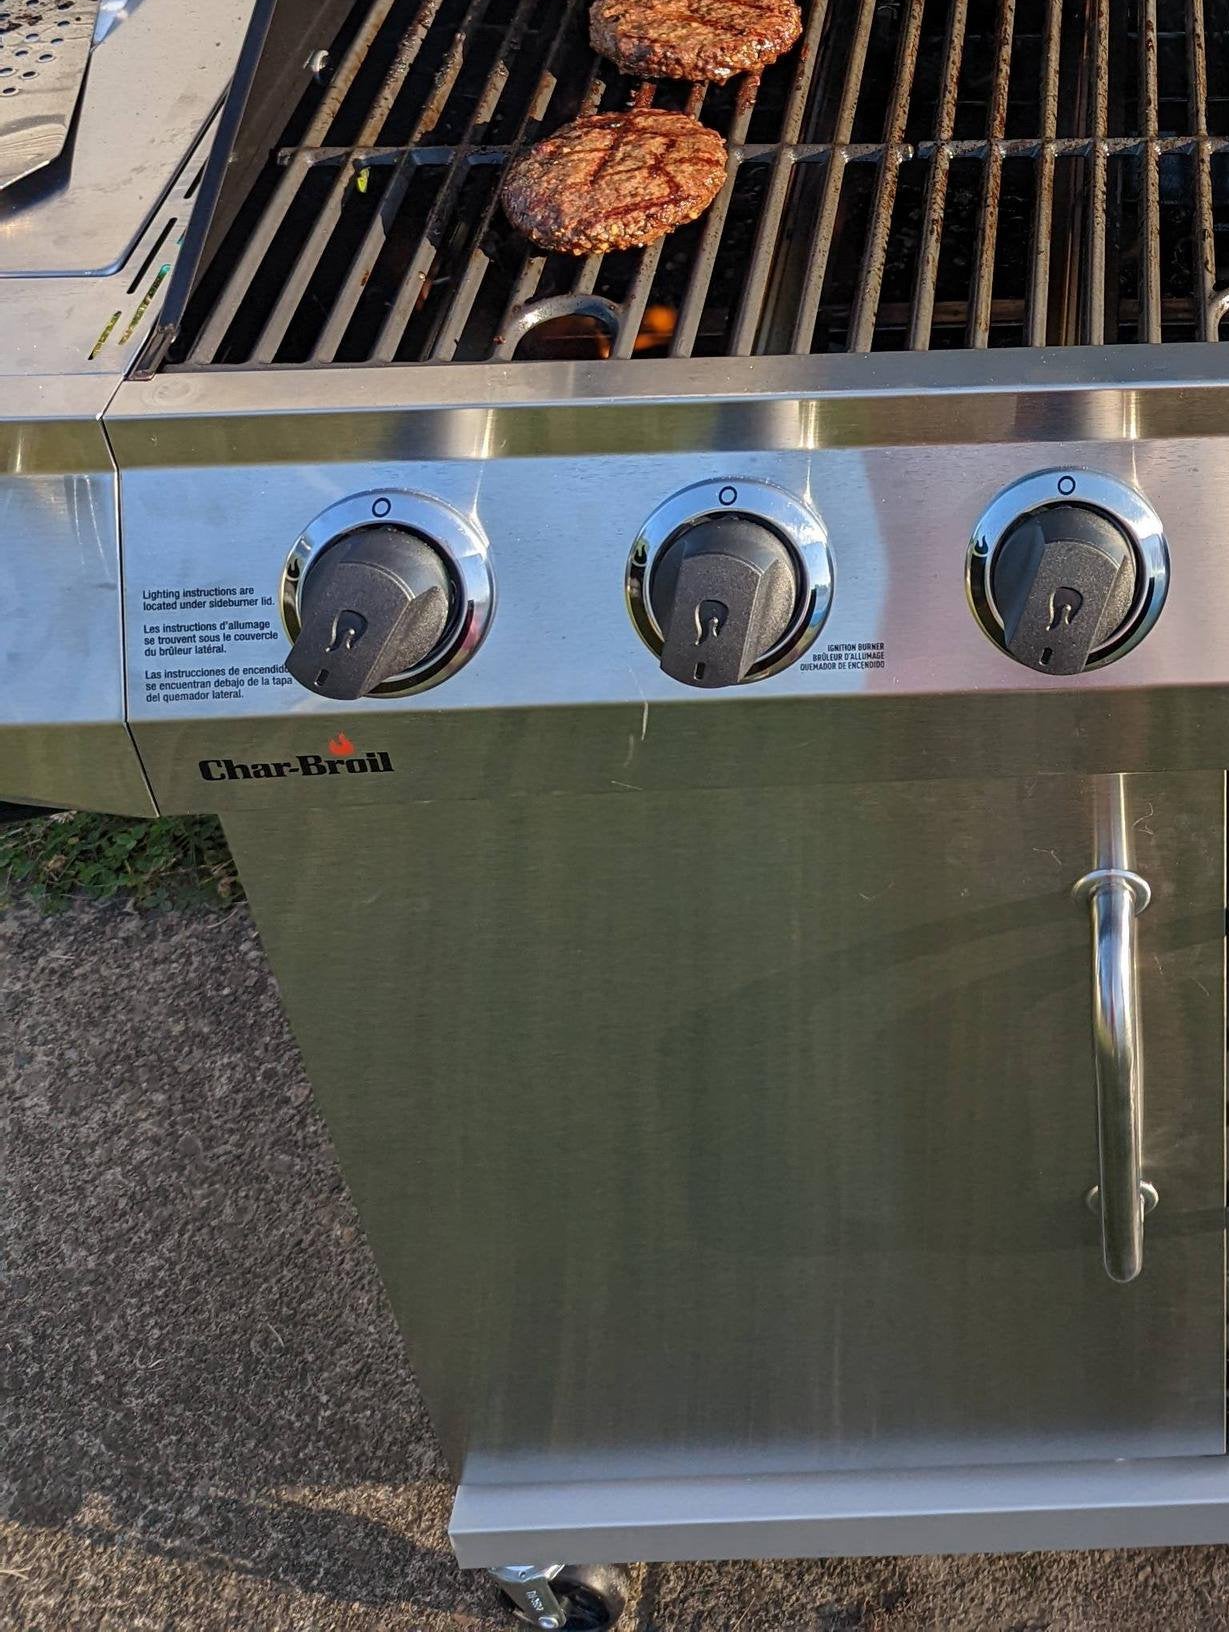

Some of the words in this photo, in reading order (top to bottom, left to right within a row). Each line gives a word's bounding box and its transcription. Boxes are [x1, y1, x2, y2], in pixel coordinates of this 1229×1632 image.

[142, 590, 180, 600] Lighting
[182, 587, 236, 598] instructions
[239, 587, 254, 595] are
[143, 601, 177, 611] located
[179, 599, 206, 609] under
[208, 597, 258, 608] sideburner
[261, 597, 275, 606] lid.
[143, 625, 160, 634] Les
[162, 622, 217, 632] instructions
[219, 620, 270, 631] d'allumage
[144, 637, 155, 645] se
[158, 634, 196, 644] trouvent
[198, 633, 220, 642] sous
[223, 633, 231, 641] le
[233, 630, 278, 641] couvercle
[144, 648, 156, 656] du
[159, 646, 192, 656] brûleur
[828, 644, 856, 652] IGNITION
[858, 643, 884, 651] BURNER
[800, 662, 836, 671] QUEMADOR
[848, 661, 884, 669] ENCENDIDO
[145, 671, 161, 679] Las
[164, 668, 226, 679] instrucciones
[228, 667, 240, 675] de
[145, 682, 156, 691] se
[159, 679, 211, 690] encuentran
[214, 678, 245, 688] debajo
[247, 677, 259, 686] de
[261, 676, 270, 685] la
[272, 676, 292, 686] tapa
[146, 693, 160, 702] del
[162, 691, 210, 702] quemador
[212, 689, 244, 699] lateral.
[199, 752, 394, 781] Char-Broil
